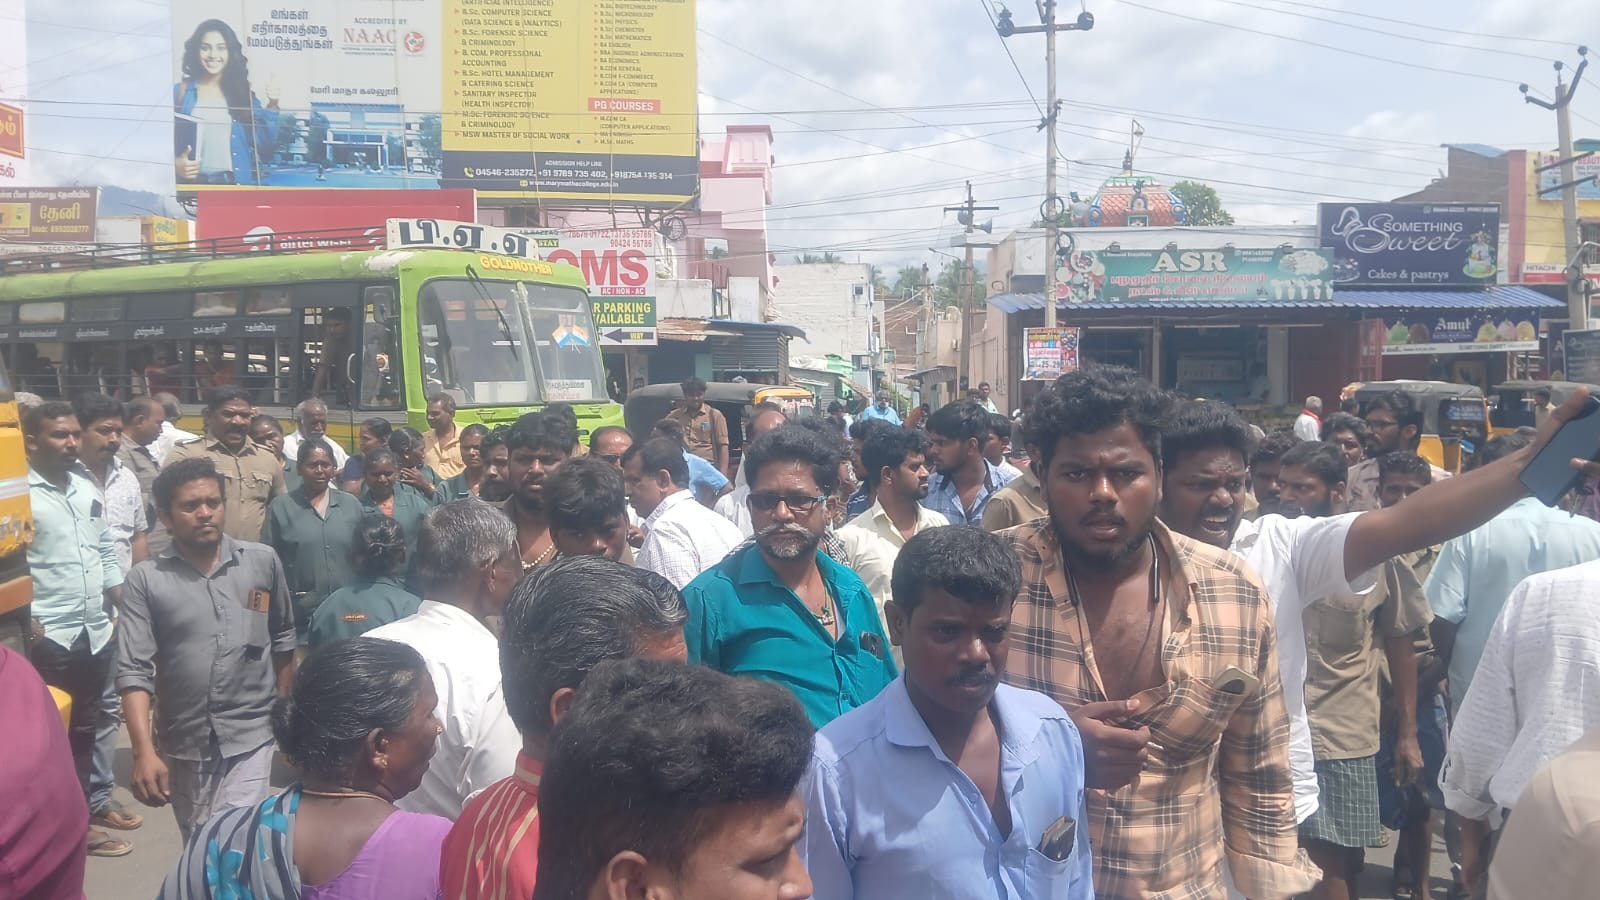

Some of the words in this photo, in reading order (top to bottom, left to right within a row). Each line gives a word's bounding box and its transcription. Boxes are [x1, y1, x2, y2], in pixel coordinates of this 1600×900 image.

[270, 8, 308, 20] உங்கள்
[252, 21, 328, 37] எதிர்காலத்தை
[344, 28, 396, 44] NAAC
[594, 101, 607, 109] PG
[610, 102, 654, 111] COURSES
[574, 170, 588, 178] 735
[40, 202, 80, 223] தேனி
[1384, 222, 1463, 232] SOMETHING
[1152, 251, 1228, 273] ASR
[1368, 268, 1397, 279] Cakes
[1400, 269, 1408, 279] &
[1411, 270, 1449, 282] pastrys
[604, 302, 651, 313] PARKING
[1435, 318, 1472, 331] Amul
